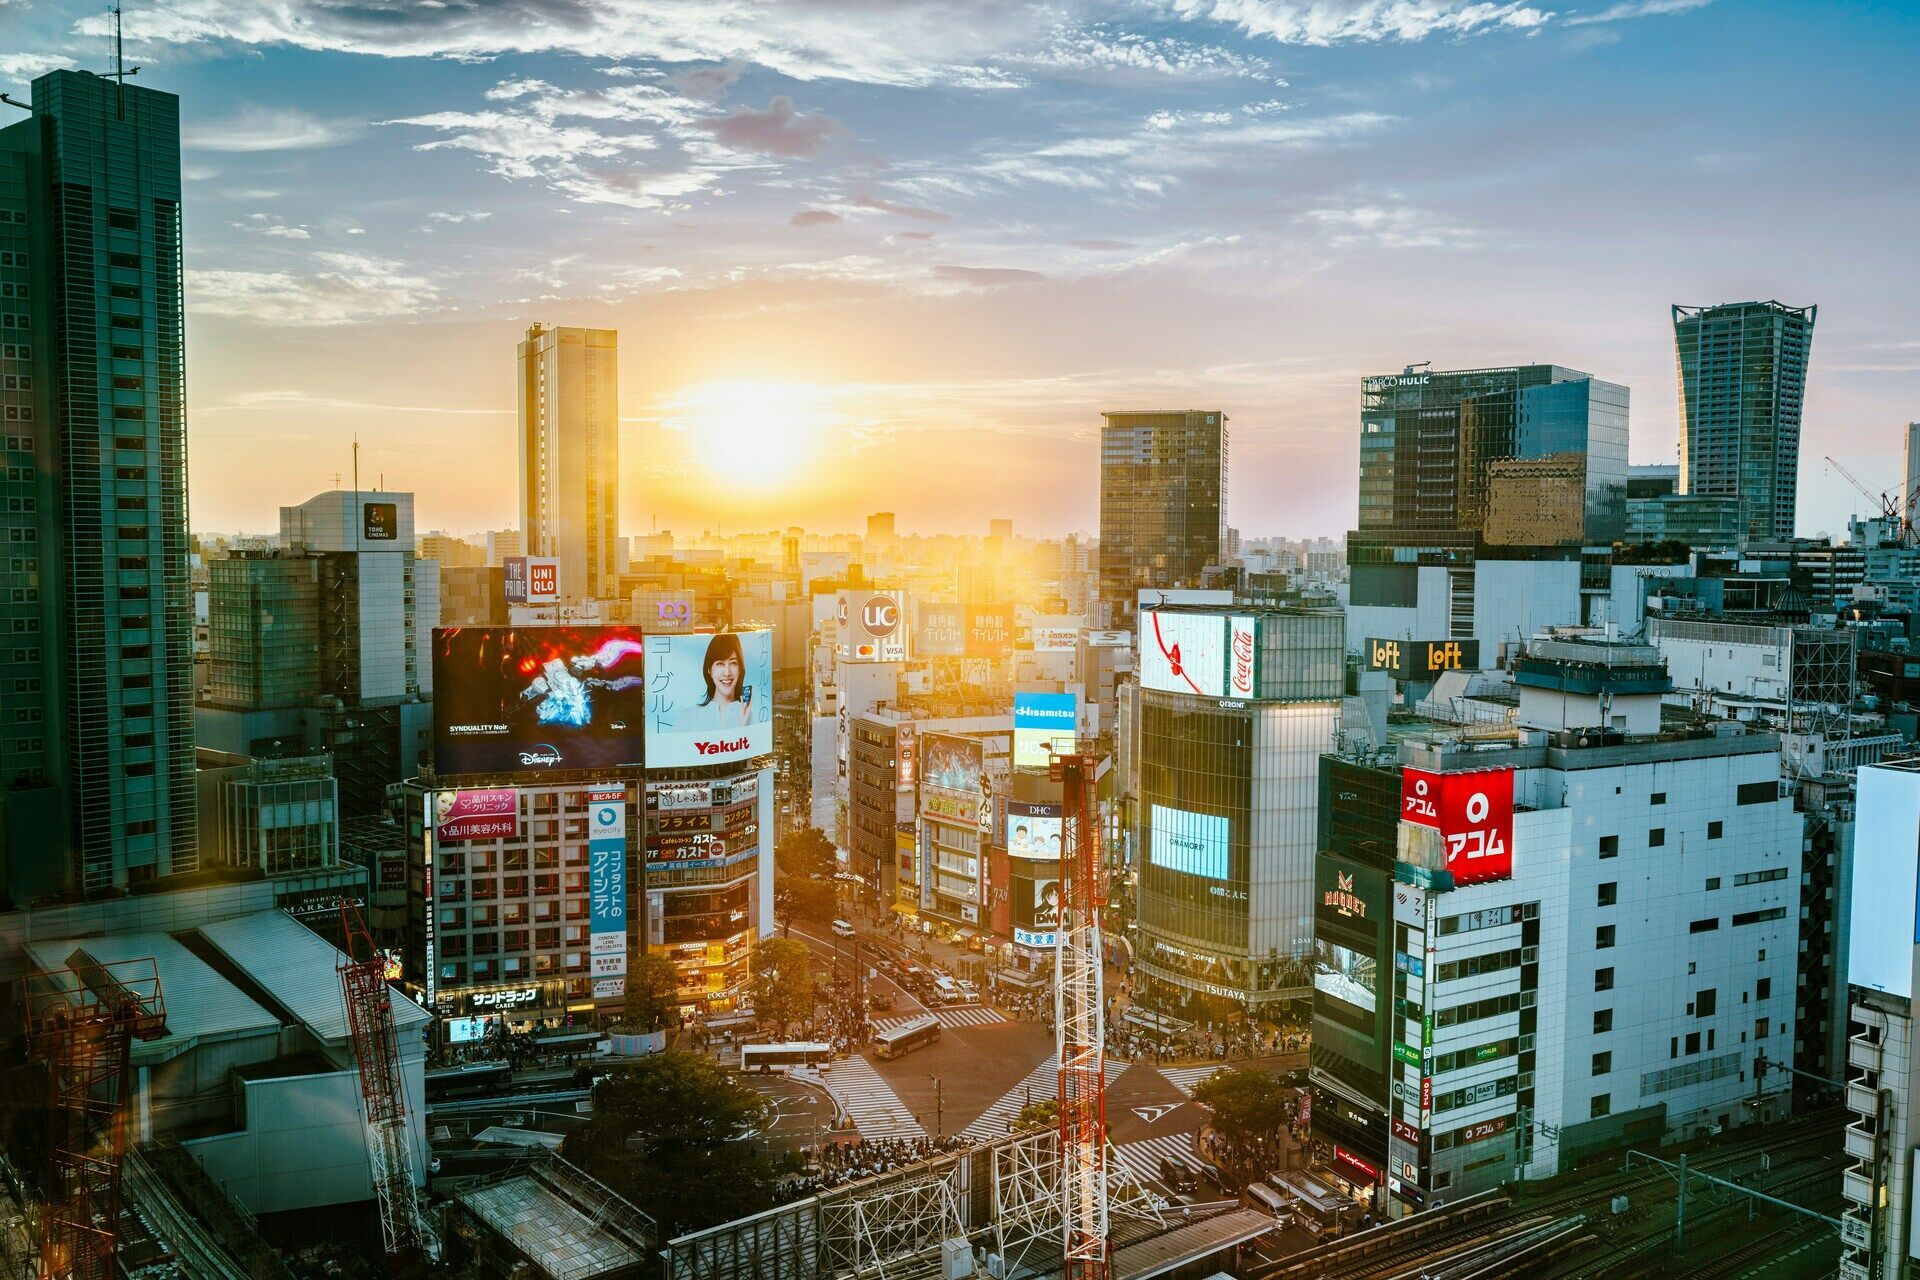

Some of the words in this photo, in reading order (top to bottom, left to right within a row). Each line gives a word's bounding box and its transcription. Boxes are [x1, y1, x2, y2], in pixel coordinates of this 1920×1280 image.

[1399, 376, 1429, 386] HULIC
[509, 563, 521, 579] THE
[533, 568, 552, 579] UNI
[505, 580, 526, 597] PRIME
[533, 580, 554, 593] QLO
[656, 600, 690, 626] 109
[885, 647, 903, 655] VISA
[651, 636, 674, 734] ヨーグルト
[759, 633, 769, 723] ヤクルトの
[1015, 707, 1074, 718] Hisamitsu
[694, 737, 750, 755] Yakult
[518, 751, 563, 767] Disney+
[472, 793, 513, 804] 品川スキン
[646, 796, 657, 804] 9F
[472, 802, 509, 812] クリニック
[1029, 806, 1051, 815] DHC
[1406, 796, 1437, 818] アコム
[448, 823, 513, 836] 品川美容外科
[593, 826, 621, 835] eyecity
[693, 834, 718, 844] ガスト
[1448, 828, 1505, 862] アコム
[646, 850, 659, 858] 7F
[676, 846, 707, 859] ガスト
[593, 850, 609, 918] アイシティ
[611, 850, 622, 917] コンタクトの
[283, 903, 324, 914] MARK
[1324, 891, 1367, 918] MAGNET
[472, 988, 536, 1005] サンドラッグ
[1205, 983, 1246, 1000] TSUTAYA
[1395, 1122, 1419, 1142] アコム
[1475, 1124, 1494, 1136] アコム
[1496, 1121, 1505, 1130] 3F
